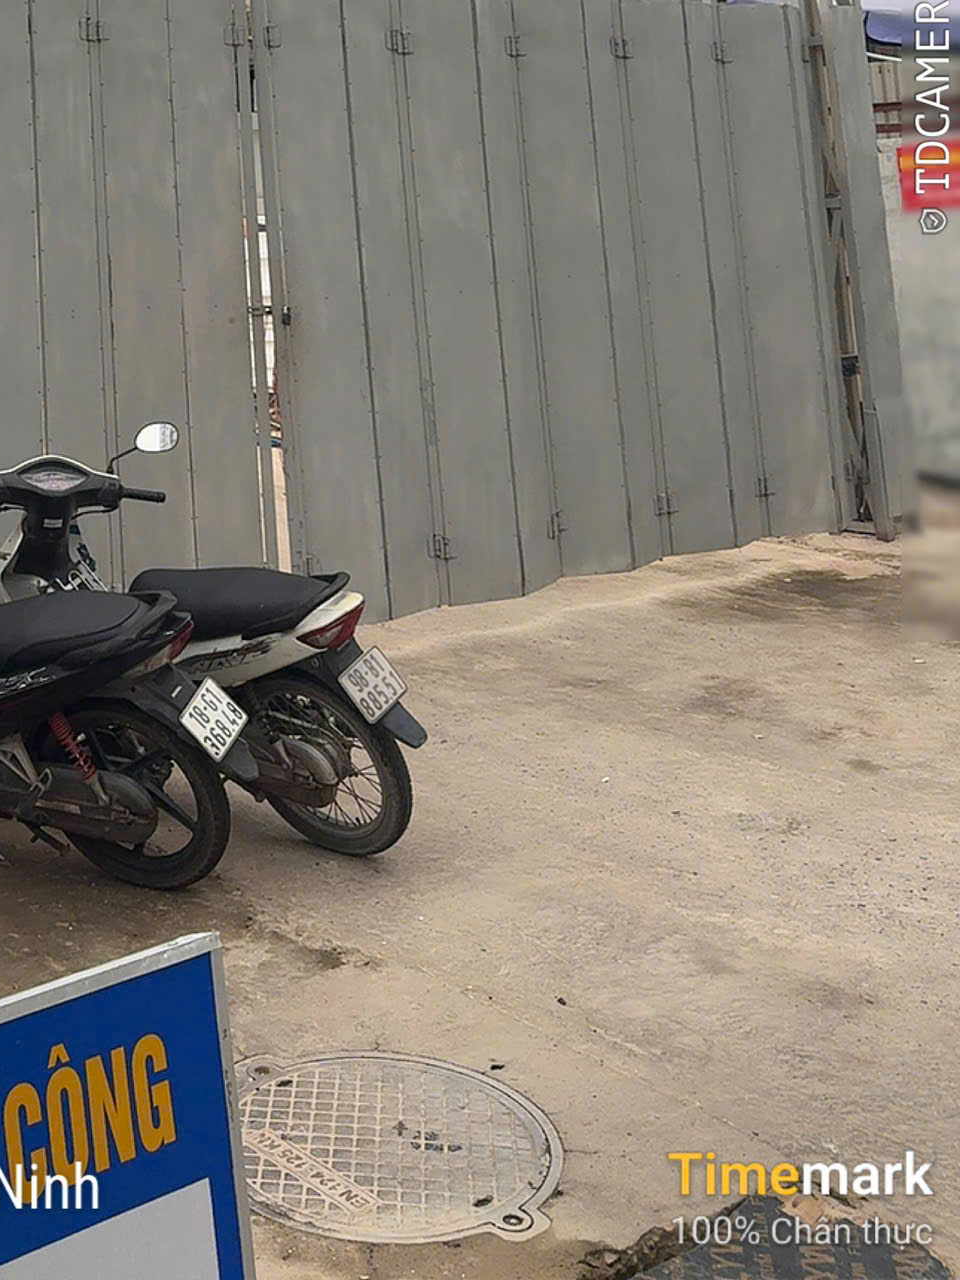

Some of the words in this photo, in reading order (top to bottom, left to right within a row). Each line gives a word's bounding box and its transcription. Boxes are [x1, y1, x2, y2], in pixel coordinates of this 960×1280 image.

[347, 654, 385, 693] 98-B1
[359, 670, 404, 718] 885.51
[188, 687, 223, 730] 18-G1
[203, 701, 244, 756] 368.48
[3, 1033, 178, 1206] CÔNG
